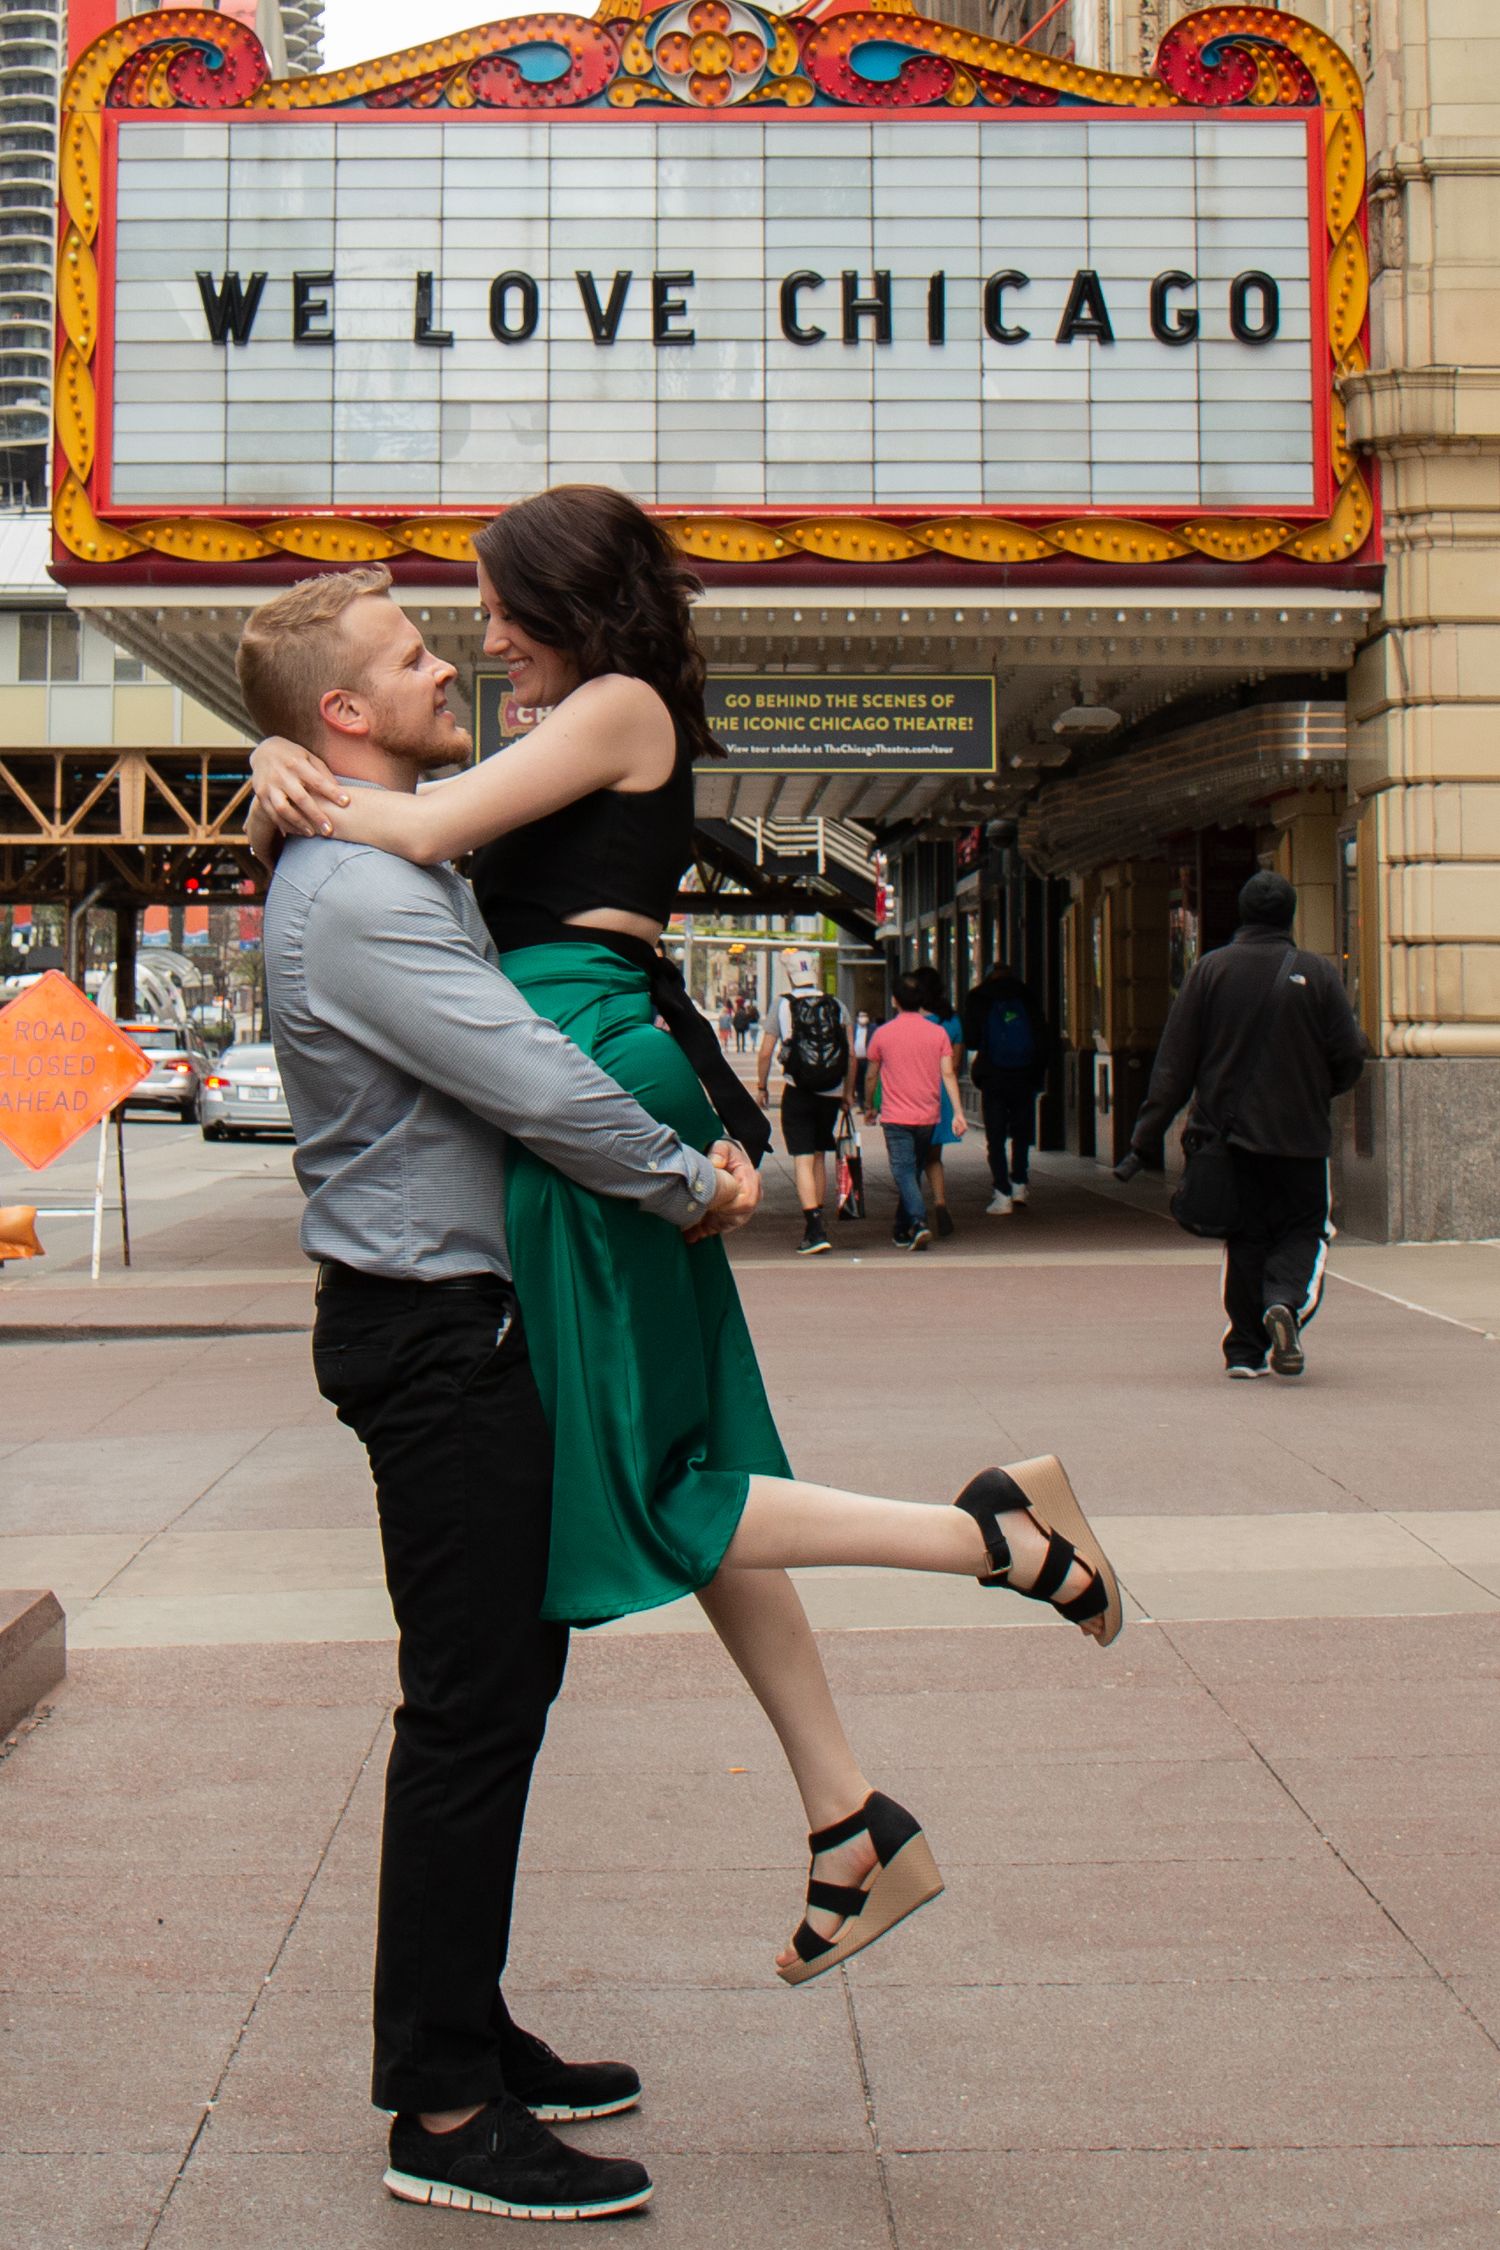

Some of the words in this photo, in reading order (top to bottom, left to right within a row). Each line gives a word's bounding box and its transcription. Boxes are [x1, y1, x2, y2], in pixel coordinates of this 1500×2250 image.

[194, 270, 336, 347] WE
[413, 269, 696, 348] LOVE
[779, 268, 1281, 348] CHICAGO
[725, 693, 752, 708] GO
[755, 693, 822, 708] BEHIND
[825, 693, 858, 708] THE
[862, 693, 927, 708] SCENES
[930, 693, 956, 708] OF
[706, 716, 740, 731] THE
[743, 716, 806, 731] ICONIC
[808, 716, 890, 731] CHICAGO
[892, 716, 974, 731] THEATRE!
[725, 743, 750, 754] View
[750, 744, 770, 754] tour
[771, 743, 811, 754] schedule
[812, 744, 823, 754] at
[823, 743, 954, 757] TheChicagoTheatre.com/tour
[14, 1020, 88, 1042] ROAD
[0, 1090, 88, 1112] AHEAD
